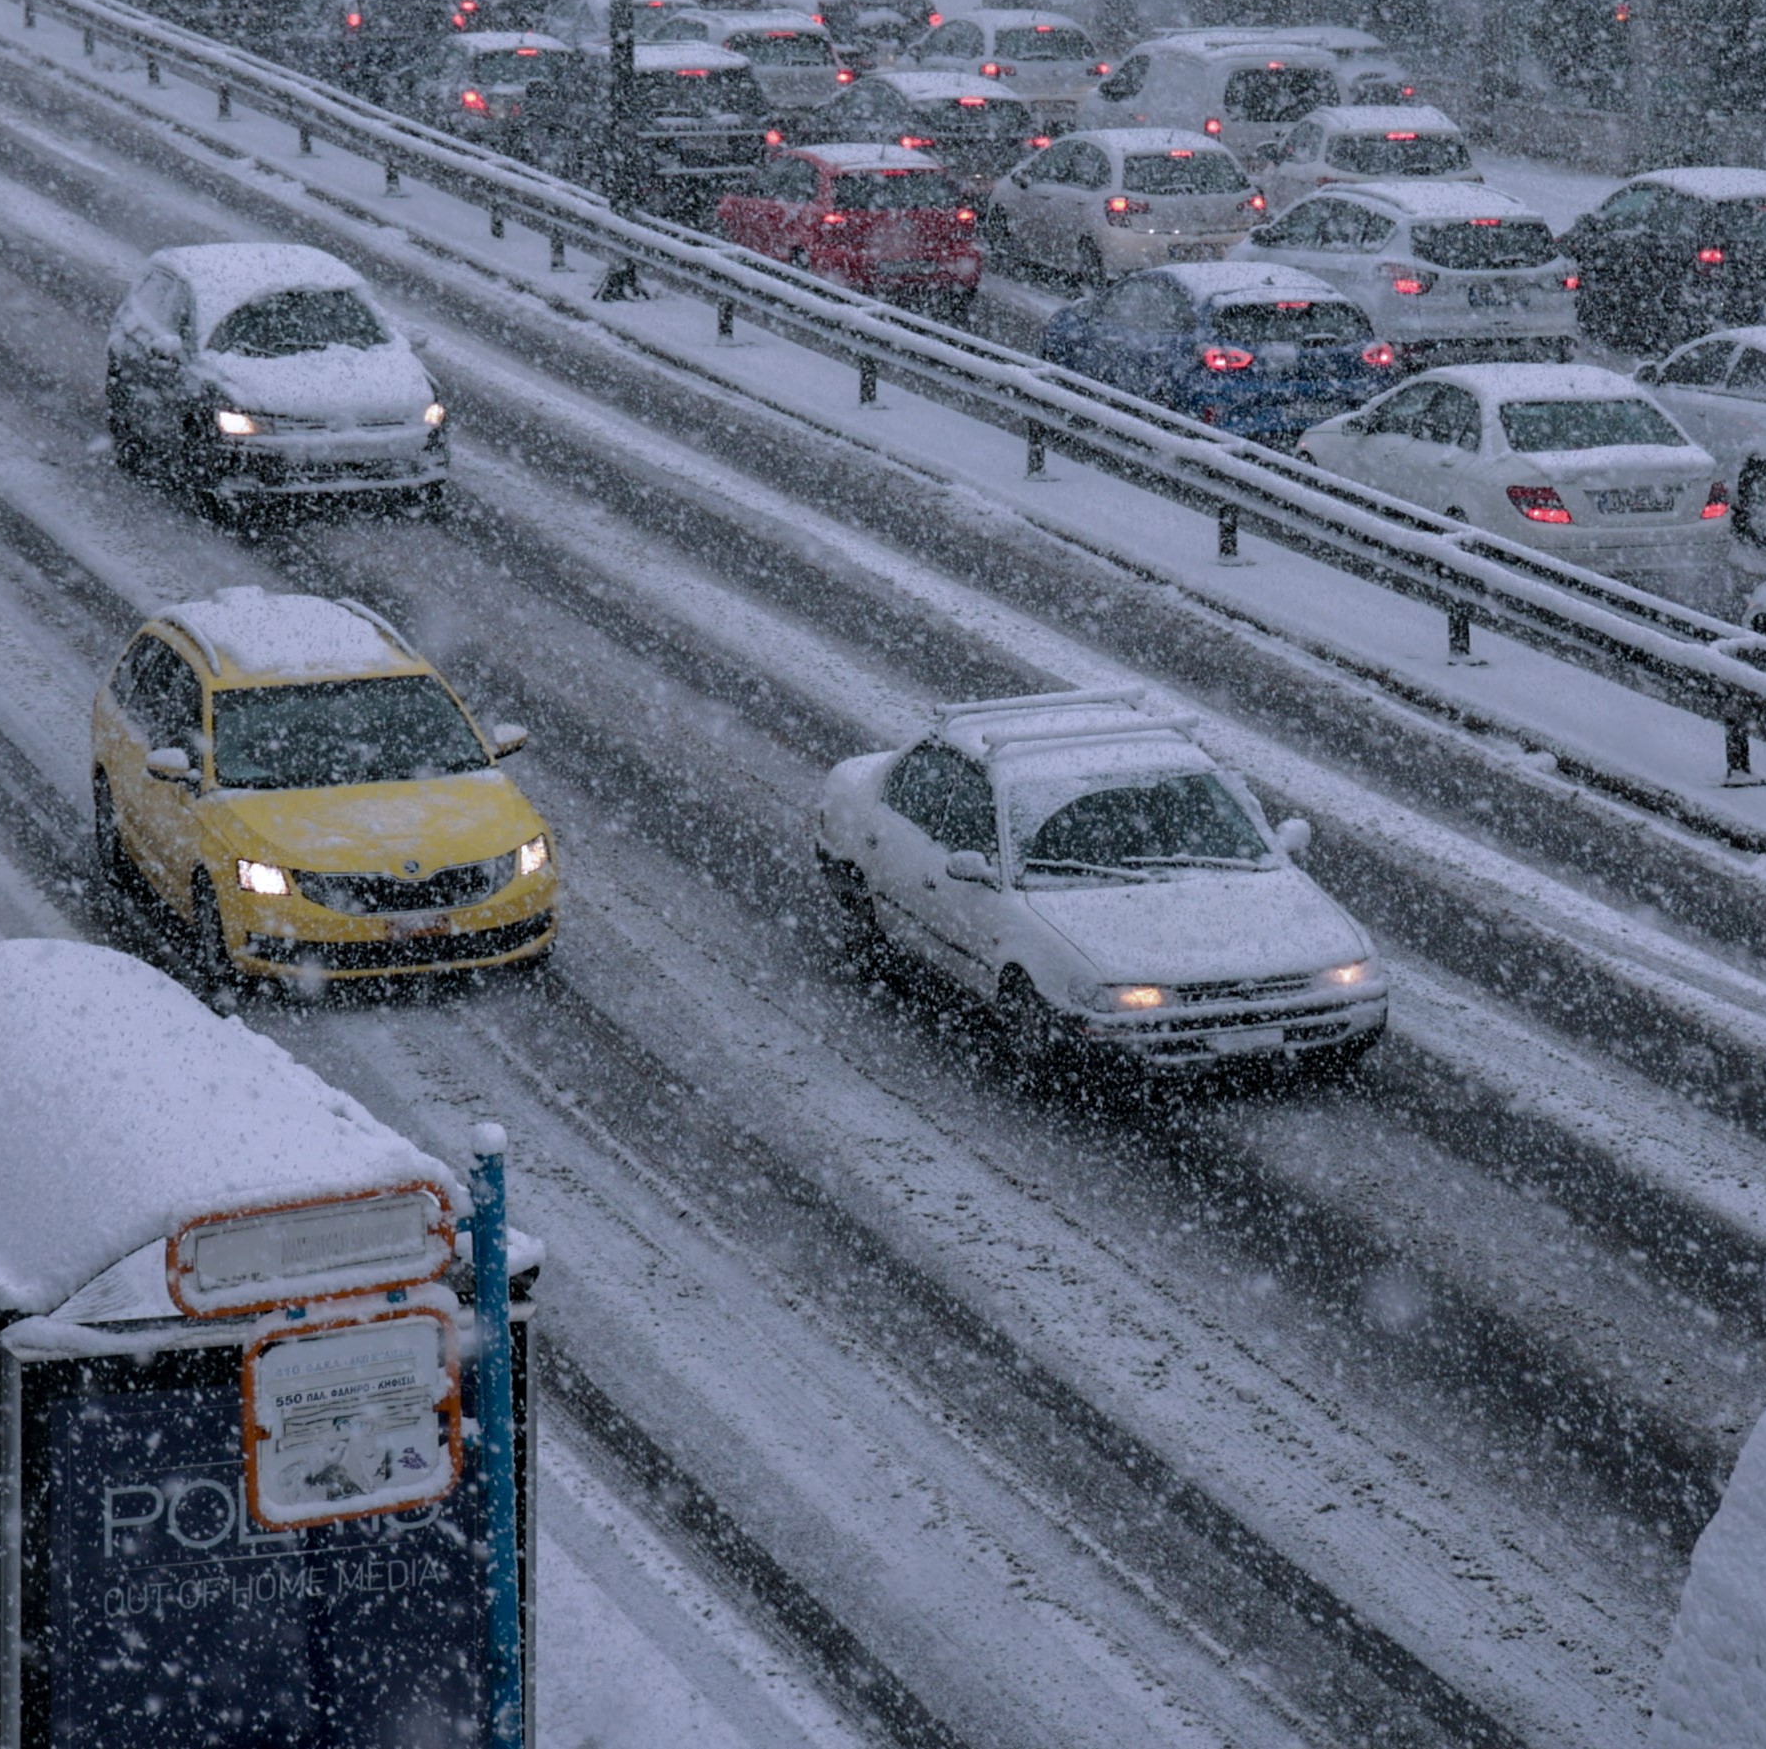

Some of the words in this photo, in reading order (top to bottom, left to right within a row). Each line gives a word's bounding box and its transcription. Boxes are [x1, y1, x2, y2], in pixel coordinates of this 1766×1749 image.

[275, 1393, 304, 1408] 550
[306, 1390, 328, 1402] ΠΑΛ.
[330, 1383, 371, 1398] ΦΑΛΗΡΟ
[377, 1375, 417, 1390] ΚΗΦΙΣΙΑ
[103, 1581, 173, 1618] OUT
[178, 1576, 226, 1611] OF
[231, 1565, 330, 1606] HOME
[337, 1556, 442, 1593] MEDIA
